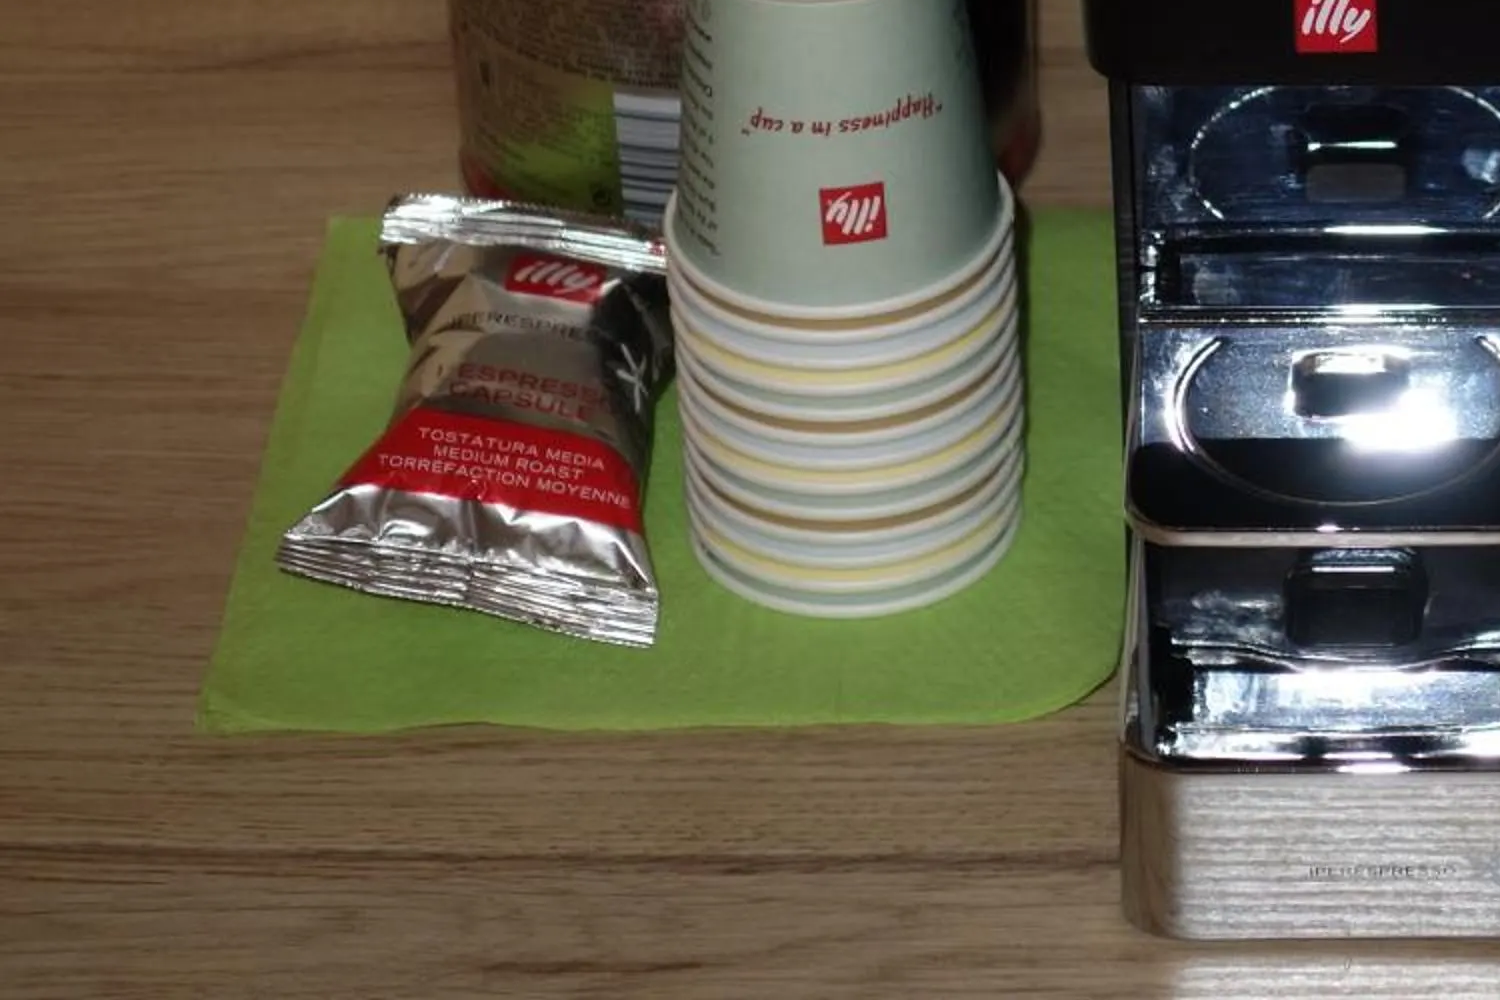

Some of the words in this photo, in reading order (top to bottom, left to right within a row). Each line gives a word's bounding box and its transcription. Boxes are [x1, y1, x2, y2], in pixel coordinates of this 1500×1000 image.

[790, 120, 804, 134] a
[811, 120, 831, 137] in
[825, 190, 882, 237] illy
[513, 260, 599, 295] illy
[450, 381, 595, 422] CAPSULE
[417, 427, 539, 458] TOSTATURA
[545, 447, 605, 471] MEDIA
[433, 445, 509, 467] MEDIUM
[515, 457, 584, 481] ROAST
[535, 478, 632, 509] MOYENNE
